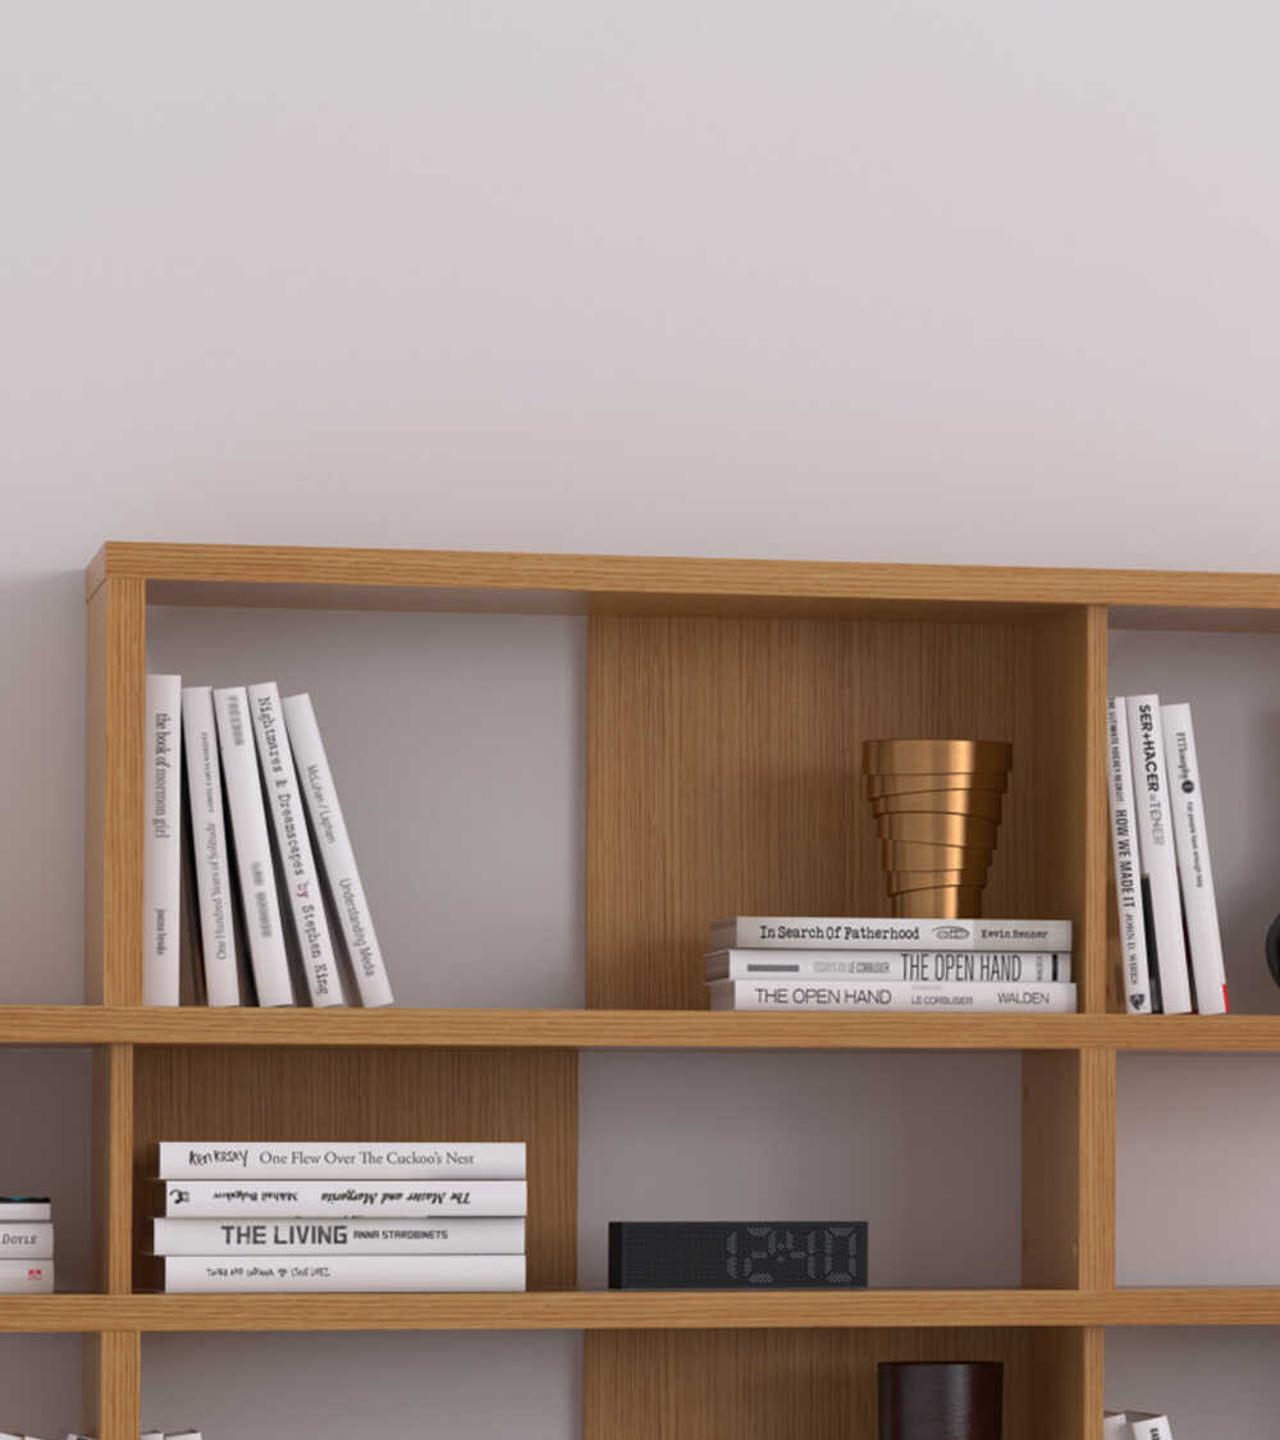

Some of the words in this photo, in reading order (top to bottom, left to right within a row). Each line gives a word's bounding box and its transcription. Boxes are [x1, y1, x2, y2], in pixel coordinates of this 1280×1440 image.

[155, 713, 170, 729] the
[155, 731, 170, 755] book
[155, 756, 170, 768] of
[154, 768, 165, 815] mormon
[151, 818, 169, 839] girl
[1114, 808, 1129, 836] HOW
[254, 696, 285, 774] Nightmares
[274, 792, 306, 877] Dreamscapes
[297, 903, 324, 960] Stephen
[311, 963, 332, 997] King
[1116, 838, 1131, 857] WE
[1118, 860, 1133, 893] MADE
[1122, 896, 1135, 907] IT
[336, 877, 367, 948] Understanding
[760, 926, 775, 939] In
[778, 926, 824, 939] Search
[826, 926, 841, 940] Of
[844, 926, 919, 940] Fatherhood
[901, 953, 928, 981] THE
[934, 954, 974, 981] OPEN
[980, 954, 1022, 982] HAND
[755, 988, 788, 1004] THE
[792, 988, 840, 1005] OPEN
[845, 989, 892, 1005] HAND
[998, 992, 1049, 1004] WALDEN
[259, 1151, 288, 1165] One
[291, 1151, 321, 1165] Flew
[324, 1151, 355, 1165] Over
[359, 1150, 383, 1165] The
[446, 1151, 475, 1165] Nest
[321, 1189, 377, 1204] Margarita
[380, 1192, 403, 1204] and
[406, 1192, 446, 1204] Master
[450, 1192, 471, 1204] The
[221, 1226, 266, 1245] THE
[274, 1226, 347, 1245] LIVING
[726, 1227, 857, 1282] 12:40
